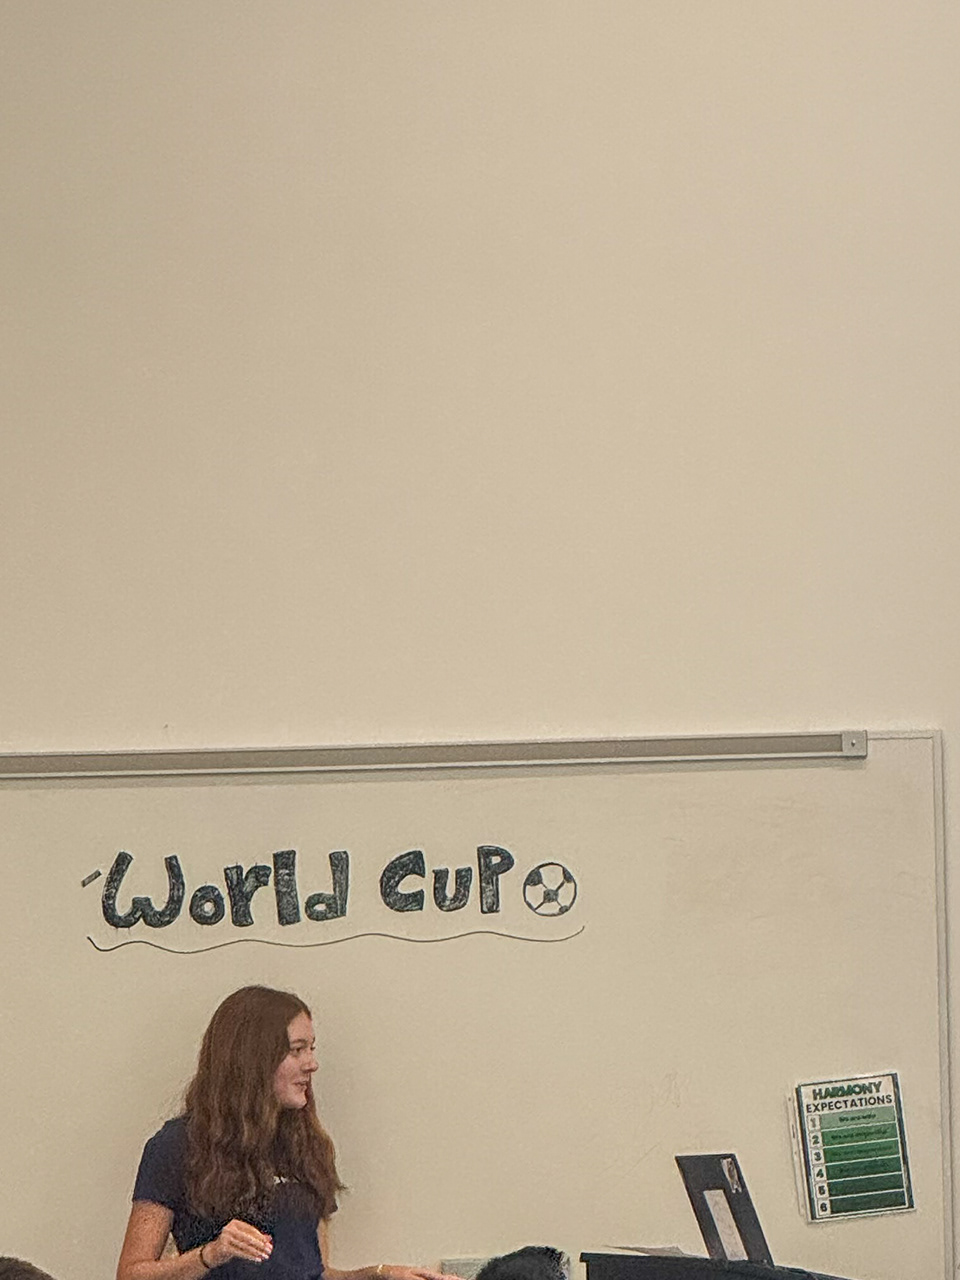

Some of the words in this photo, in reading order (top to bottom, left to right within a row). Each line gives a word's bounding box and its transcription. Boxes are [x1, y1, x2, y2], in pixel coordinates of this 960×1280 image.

[102, 849, 350, 929] World
[812, 1081, 883, 1101] HARMONY
[806, 1094, 893, 1114] EXPECTATIONS
[810, 1118, 817, 1128] 1
[811, 1134, 820, 1146] 2
[813, 1151, 822, 1162] 3
[815, 1169, 824, 1179] 4
[818, 1185, 826, 1195] 5
[820, 1202, 828, 1212] 6
